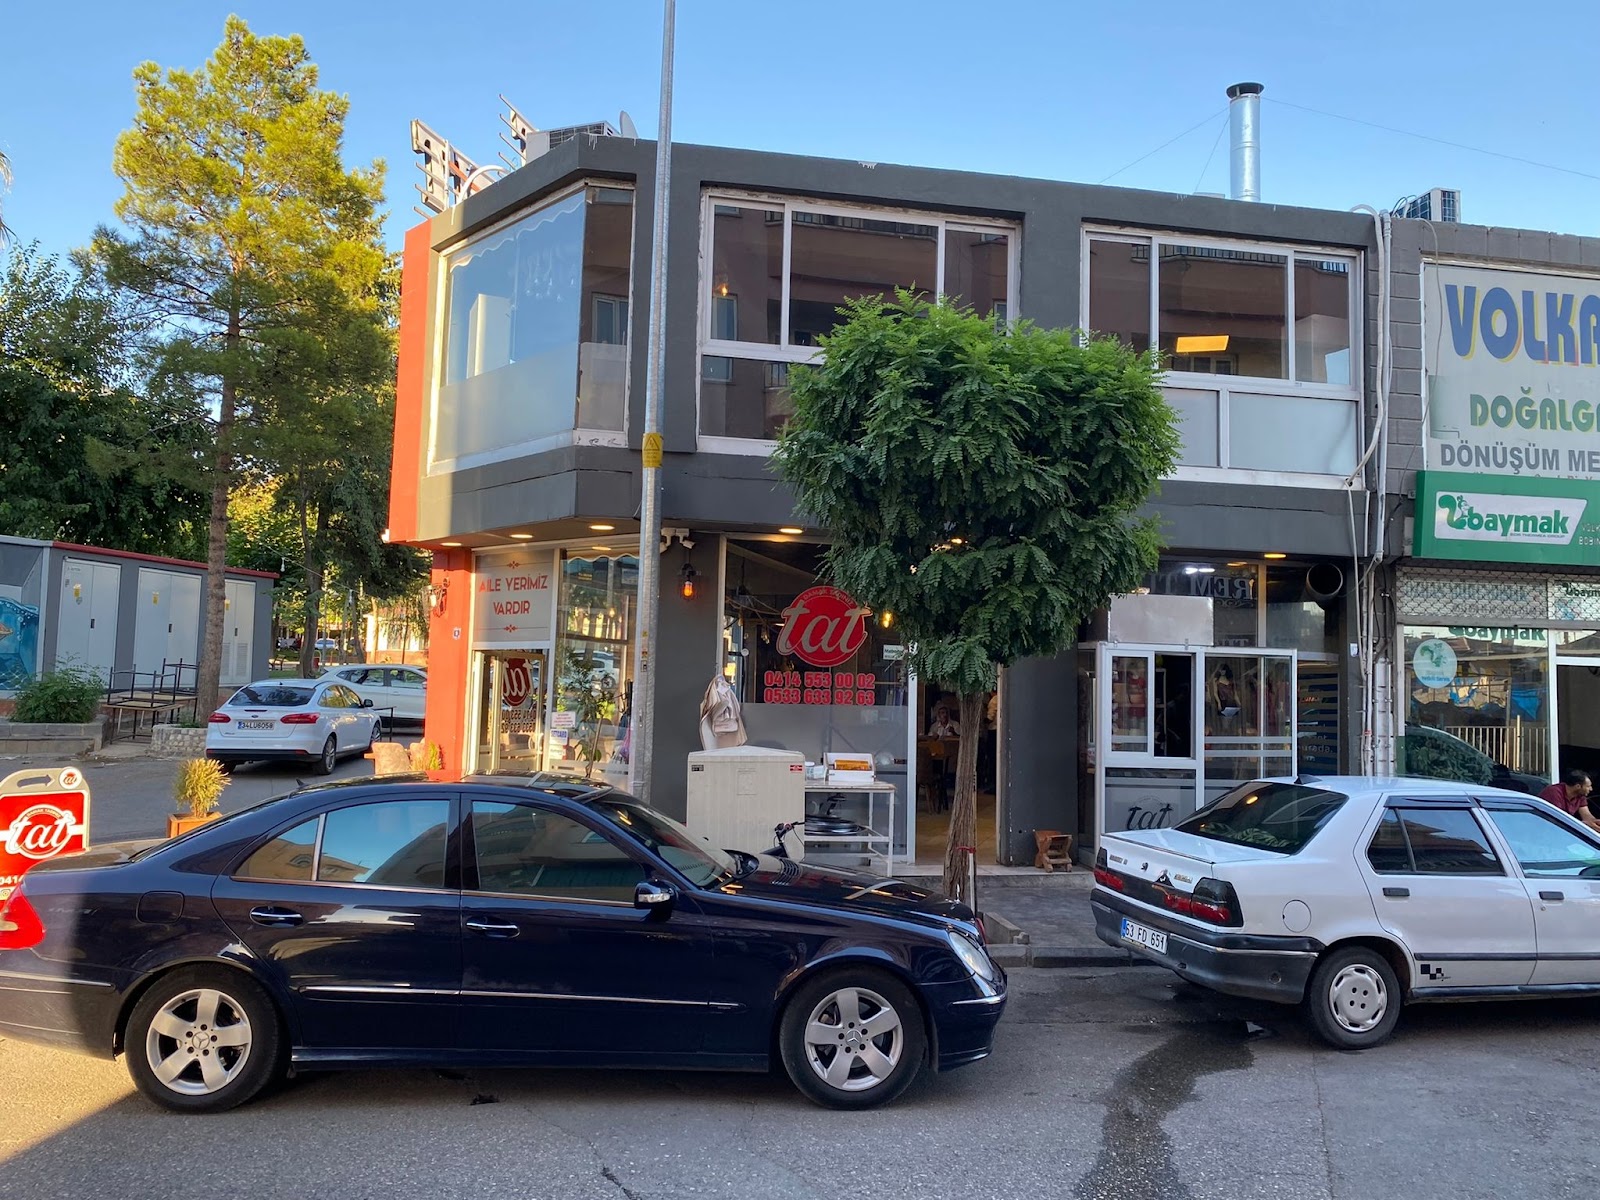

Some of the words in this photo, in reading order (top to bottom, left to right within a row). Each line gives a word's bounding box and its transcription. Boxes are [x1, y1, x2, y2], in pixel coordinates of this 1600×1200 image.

[1469, 385, 1600, 432] DOĞALG
[1440, 440, 1561, 474] DÖNÜŞÜM
[1568, 449, 1600, 472] ME
[1467, 506, 1569, 537] baymak
[506, 573, 548, 591] YERİMİZ
[493, 600, 530, 615] VARDIR
[778, 601, 872, 655] tat
[764, 670, 801, 688] 0414
[804, 671, 832, 688] 553
[834, 672, 854, 689] 00
[856, 673, 876, 690] 02
[764, 687, 801, 704] 0533
[803, 688, 832, 705] 633
[834, 689, 854, 706] 92
[856, 690, 876, 706] 63
[1126, 803, 1171, 830] tat
[10, 813, 74, 852] tat
